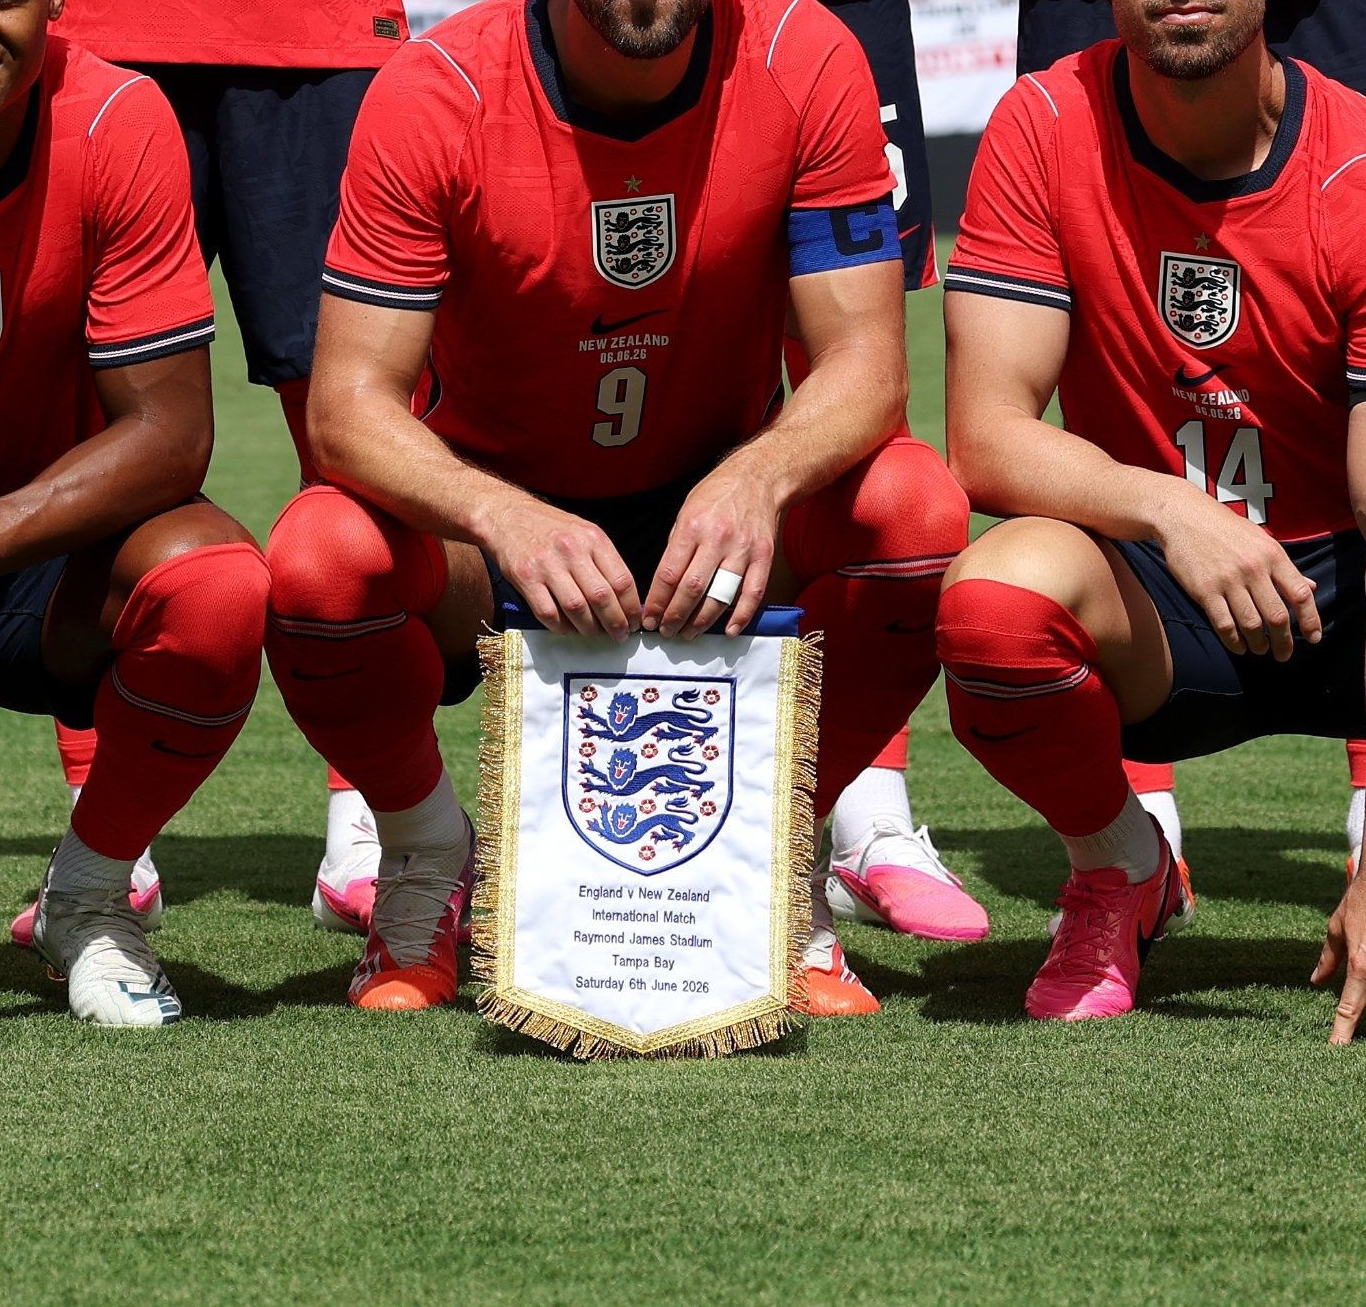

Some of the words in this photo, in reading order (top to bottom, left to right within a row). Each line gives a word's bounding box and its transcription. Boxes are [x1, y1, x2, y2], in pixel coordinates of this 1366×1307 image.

[828, 205, 884, 256] C
[579, 338, 608, 352] NEW
[611, 334, 669, 349] ZEALAND
[600, 348, 647, 364] 06.06.26
[1172, 387, 1197, 403] NEW
[1201, 389, 1250, 406] ZEALAND
[592, 366, 647, 447] 9
[1176, 420, 1273, 525] 14
[579, 885, 624, 902] England
[627, 888, 634, 899] v
[638, 886, 662, 900] New
[667, 888, 710, 903] Zealand
[592, 909, 659, 923] International
[663, 911, 696, 925] Match
[573, 930, 625, 946] Raymond
[629, 932, 666, 946] James
[671, 934, 713, 949] Stadium
[612, 954, 649, 969] Tampa
[654, 956, 675, 971] Bay
[575, 976, 625, 992] Saturday
[628, 977, 647, 991] 6th
[651, 978, 677, 992] June
[682, 980, 710, 994] 2026
